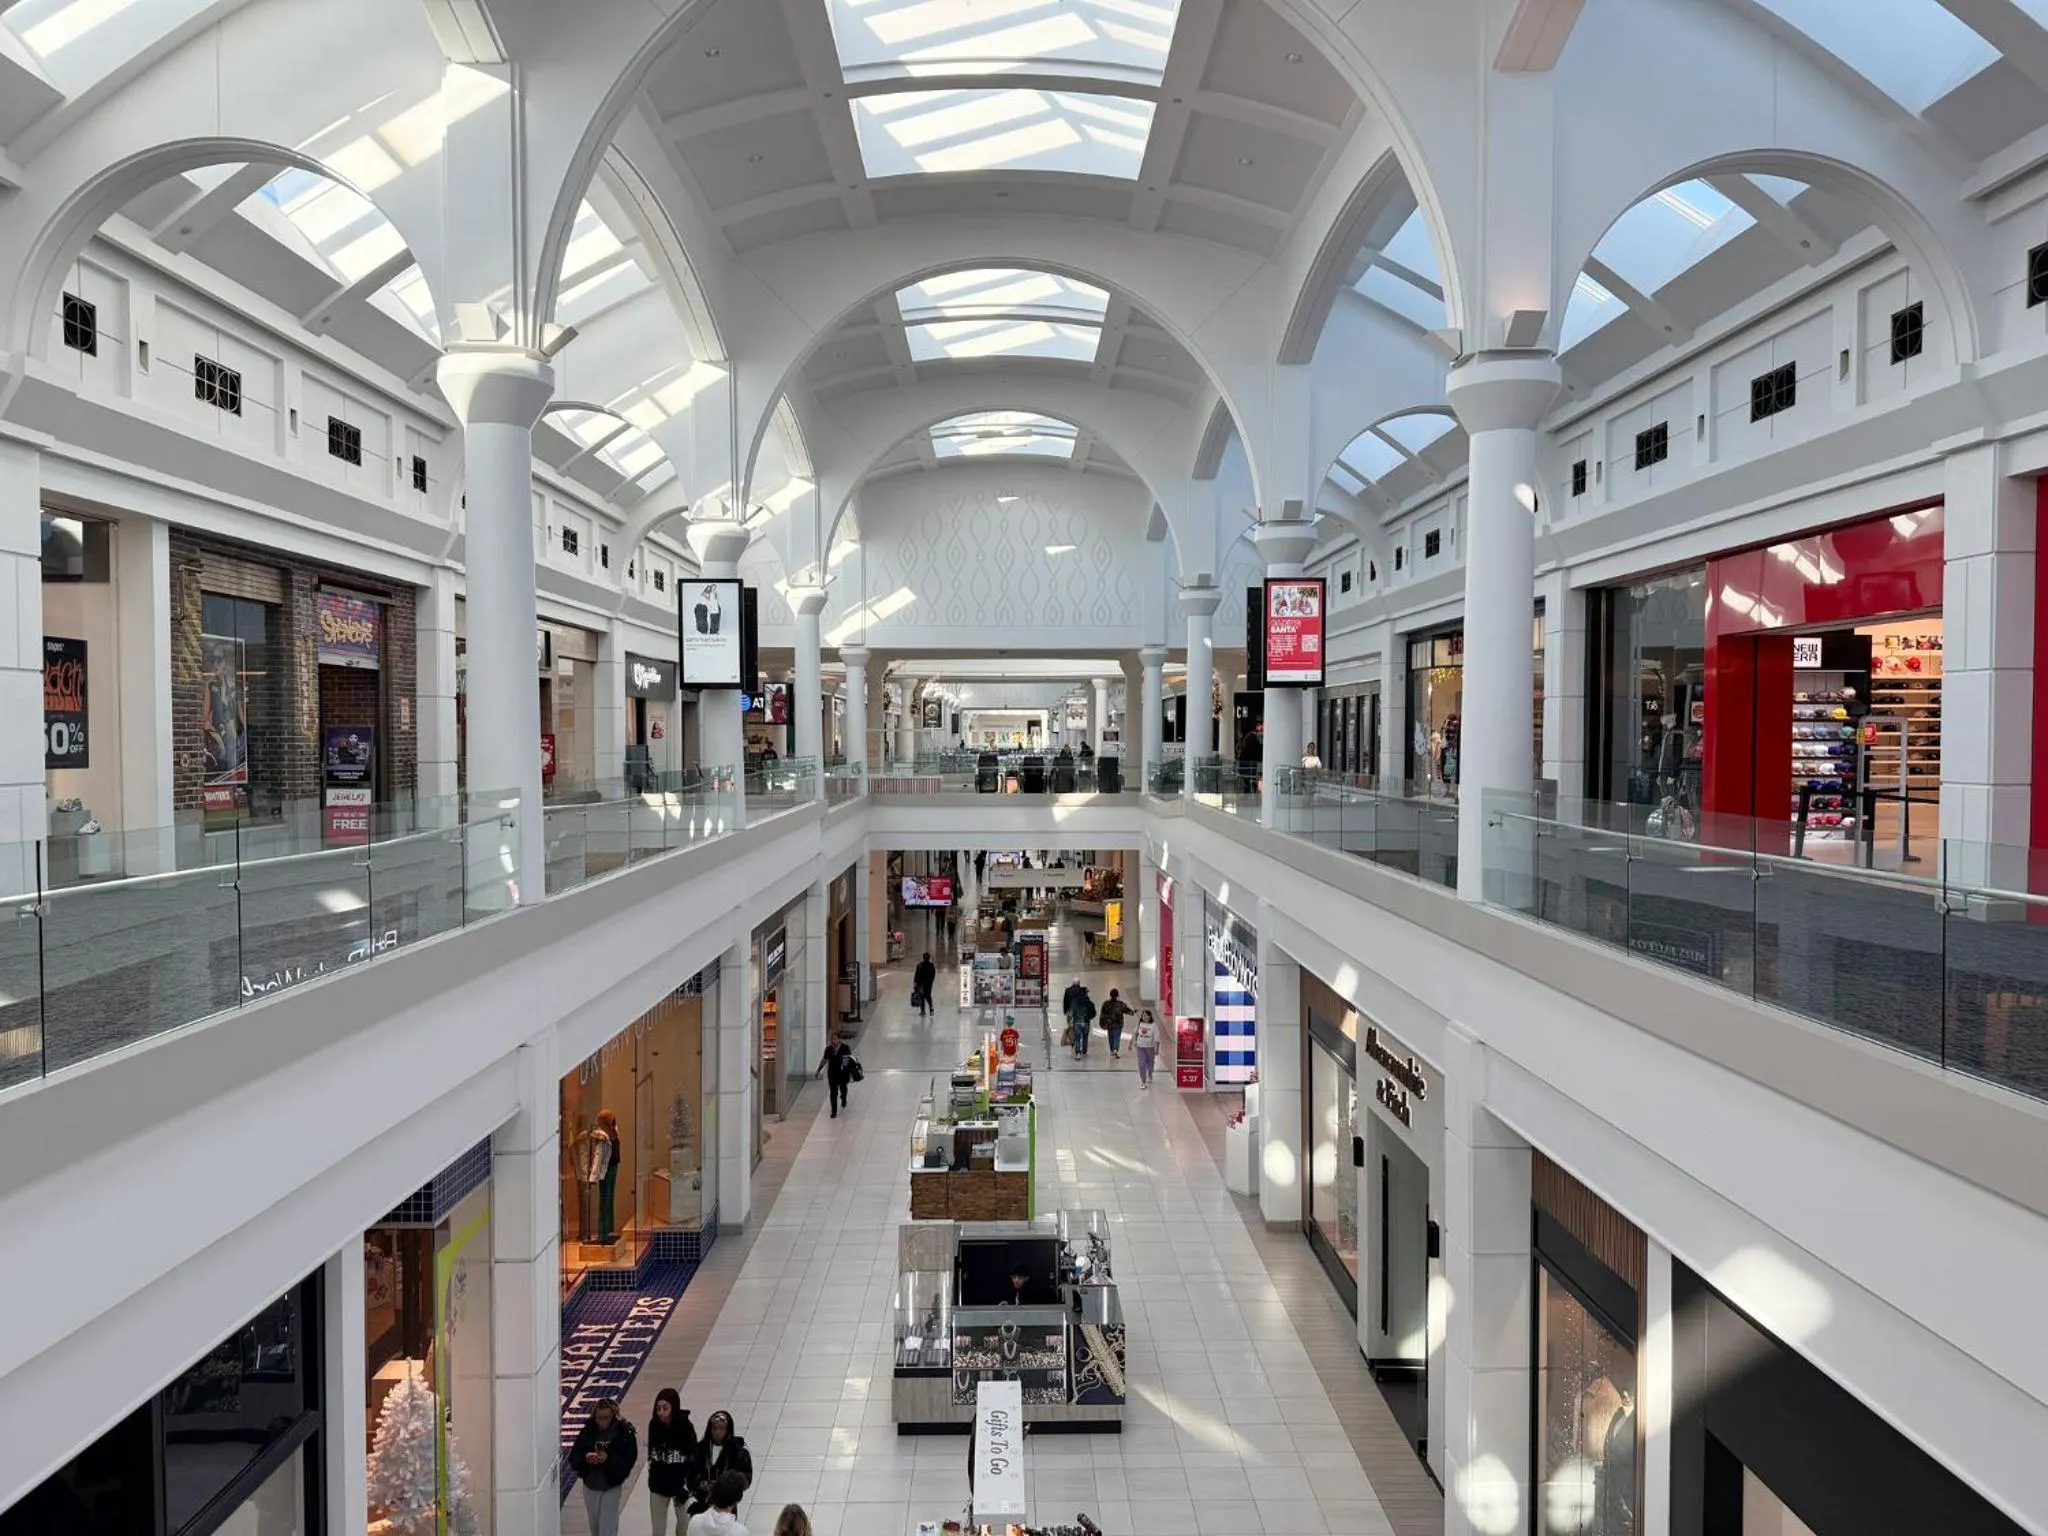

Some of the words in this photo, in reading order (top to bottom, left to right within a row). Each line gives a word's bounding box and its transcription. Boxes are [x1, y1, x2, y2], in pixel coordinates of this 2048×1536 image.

[1271, 624, 1297, 633] SANTA
[69, 745, 84, 753] OFF
[333, 819, 368, 830] FREE
[984, 1409, 1009, 1438] Gifts
[990, 1441, 1009, 1455] To
[990, 1457, 1010, 1475] Go
